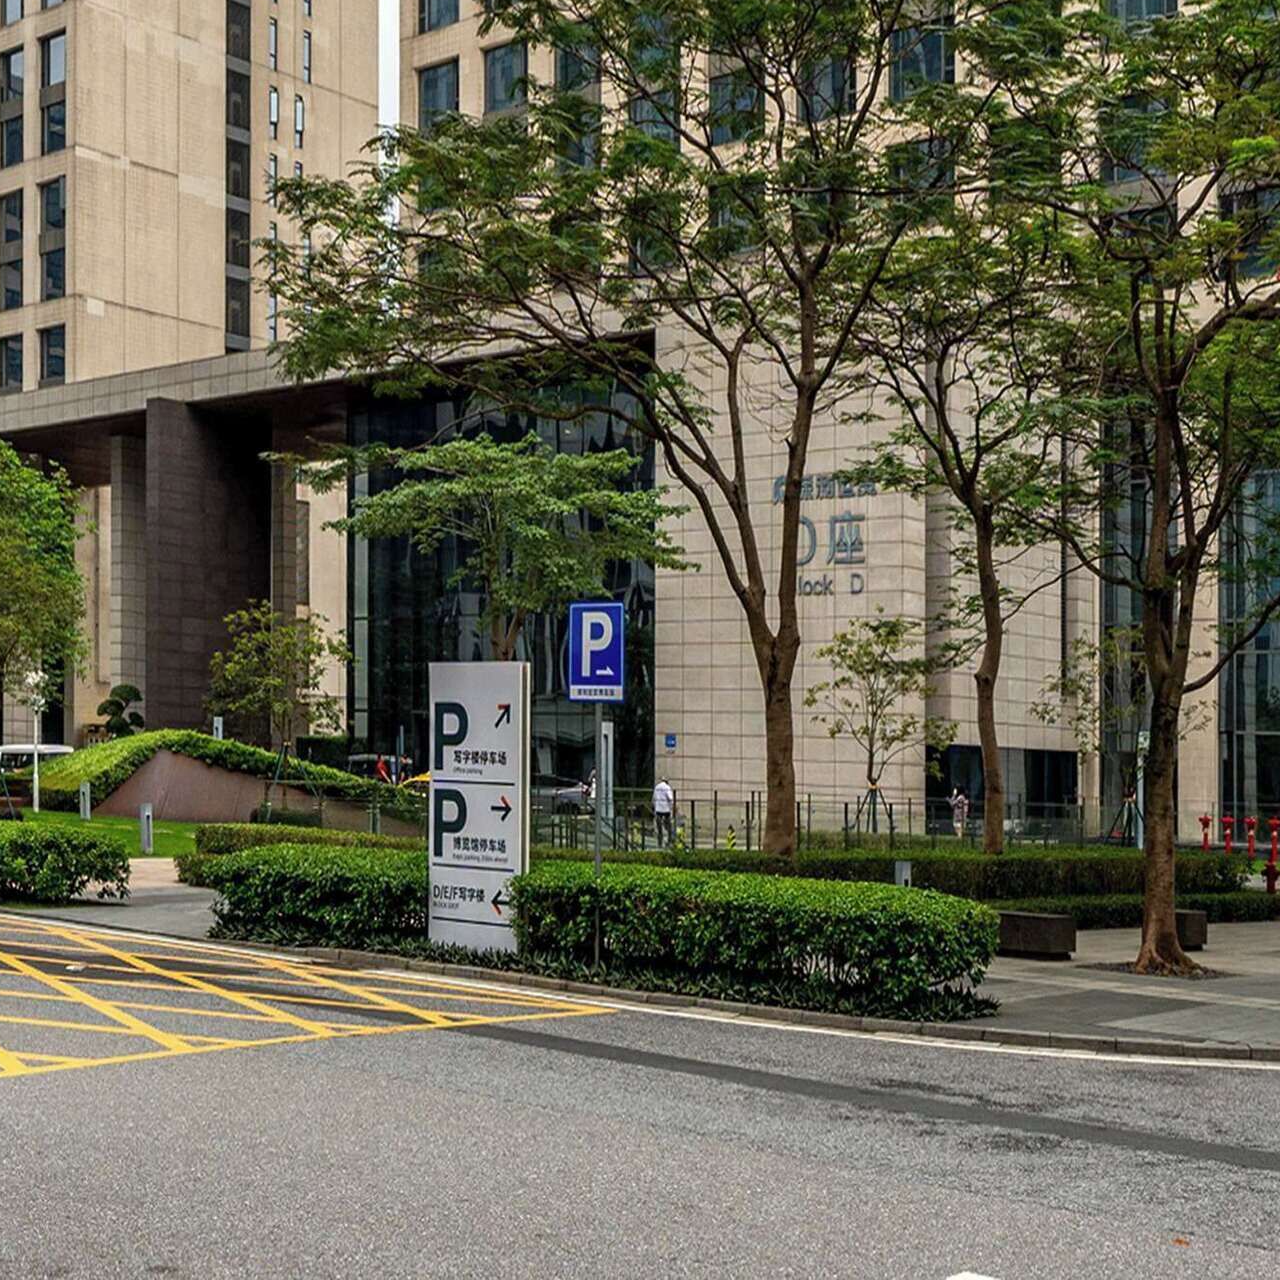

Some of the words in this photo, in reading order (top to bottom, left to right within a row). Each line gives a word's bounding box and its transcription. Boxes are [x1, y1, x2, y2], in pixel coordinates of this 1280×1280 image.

[797, 574, 834, 596] lock
[850, 573, 864, 595] D
[581, 611, 613, 677] P
[434, 702, 468, 770] P
[453, 750, 507, 766] 写字楼停车场
[434, 789, 467, 858] P
[453, 836, 507, 854] 博览馆停车场
